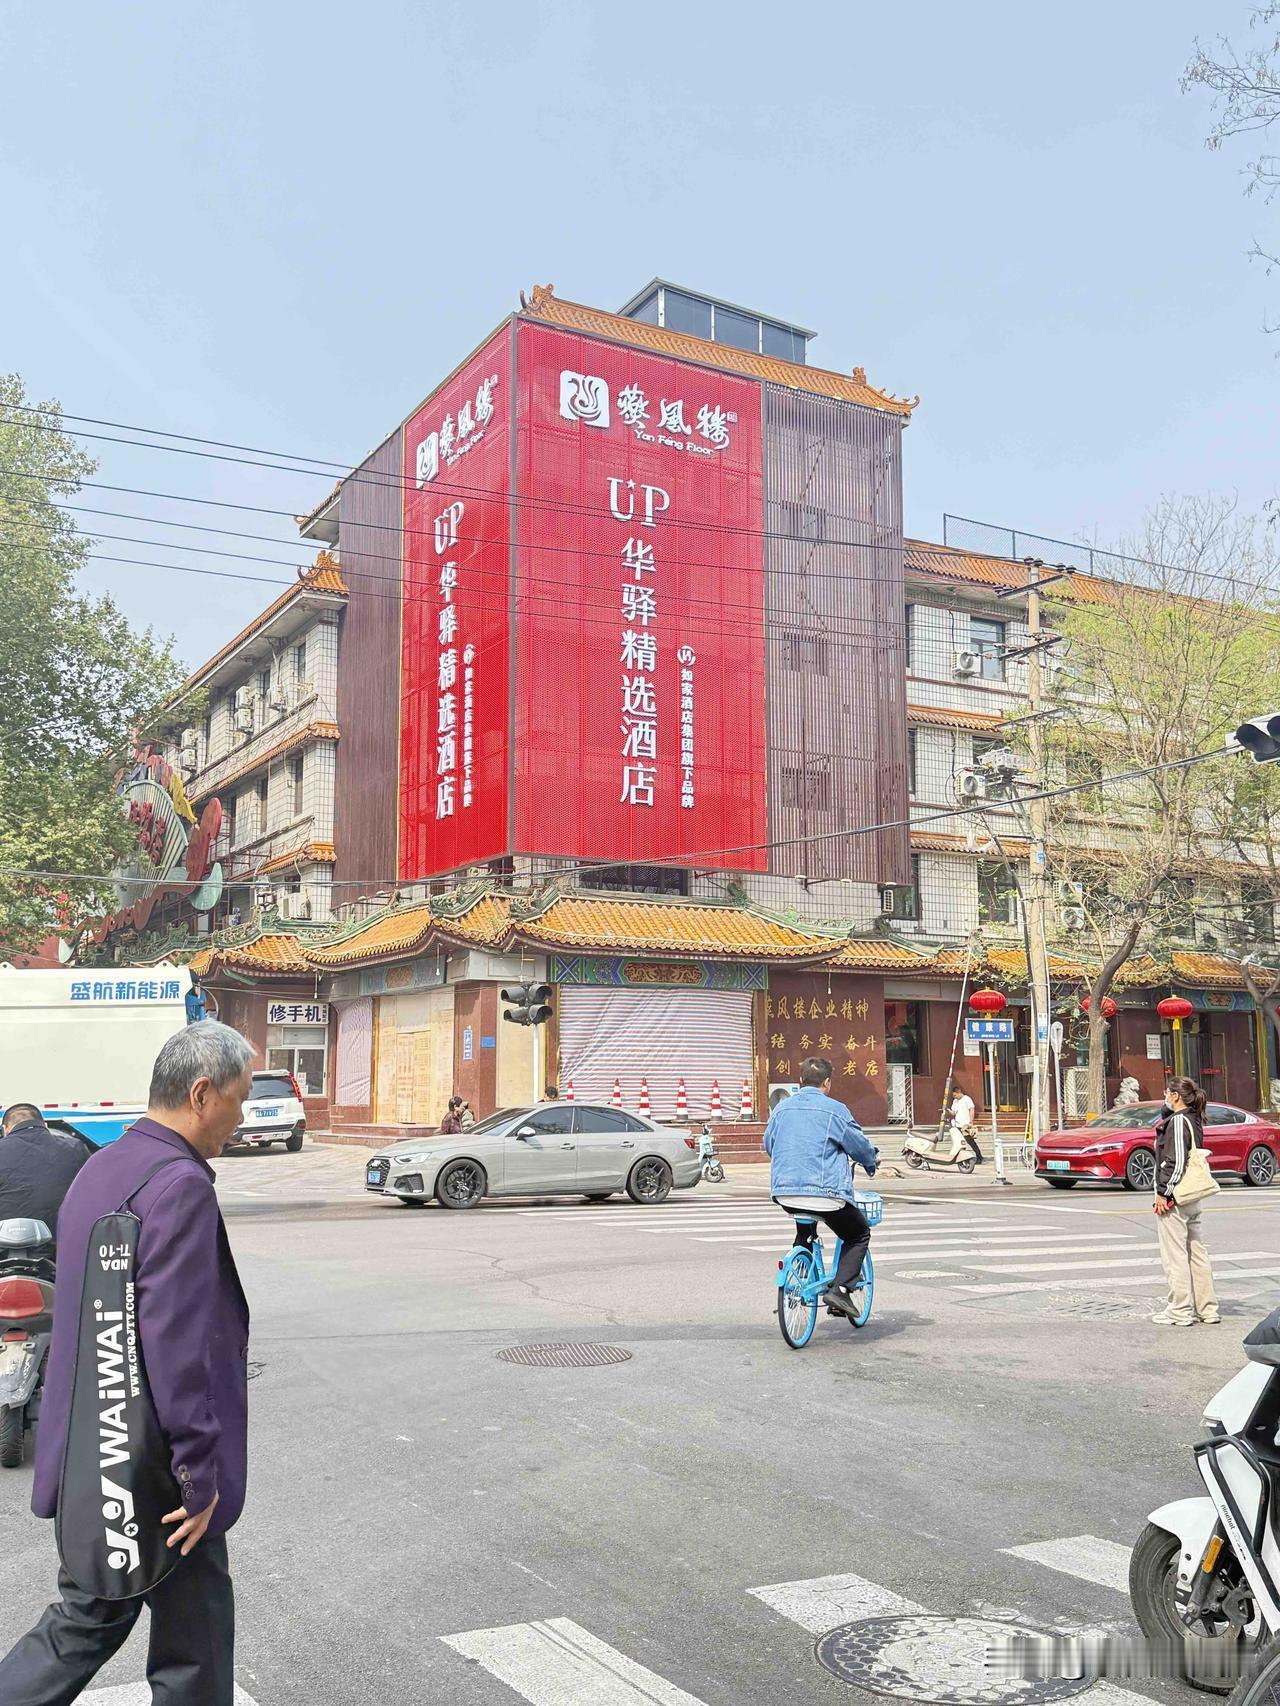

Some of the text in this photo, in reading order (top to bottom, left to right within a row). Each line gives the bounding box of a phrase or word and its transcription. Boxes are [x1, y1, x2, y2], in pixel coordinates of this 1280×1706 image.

[634, 429, 655, 442] Yan
[686, 442, 714, 455] Floor
[606, 476, 671, 528] UP
[620, 537, 658, 808] 华驿精选酒店
[680, 668, 695, 809] 如家酒店集团旗下品牌
[71, 981, 181, 1001] 盛航新能源
[269, 1004, 322, 1023] 修手机
[100, 1258, 129, 1271] NDA
[1221, 1504, 1236, 1530] ninebot
